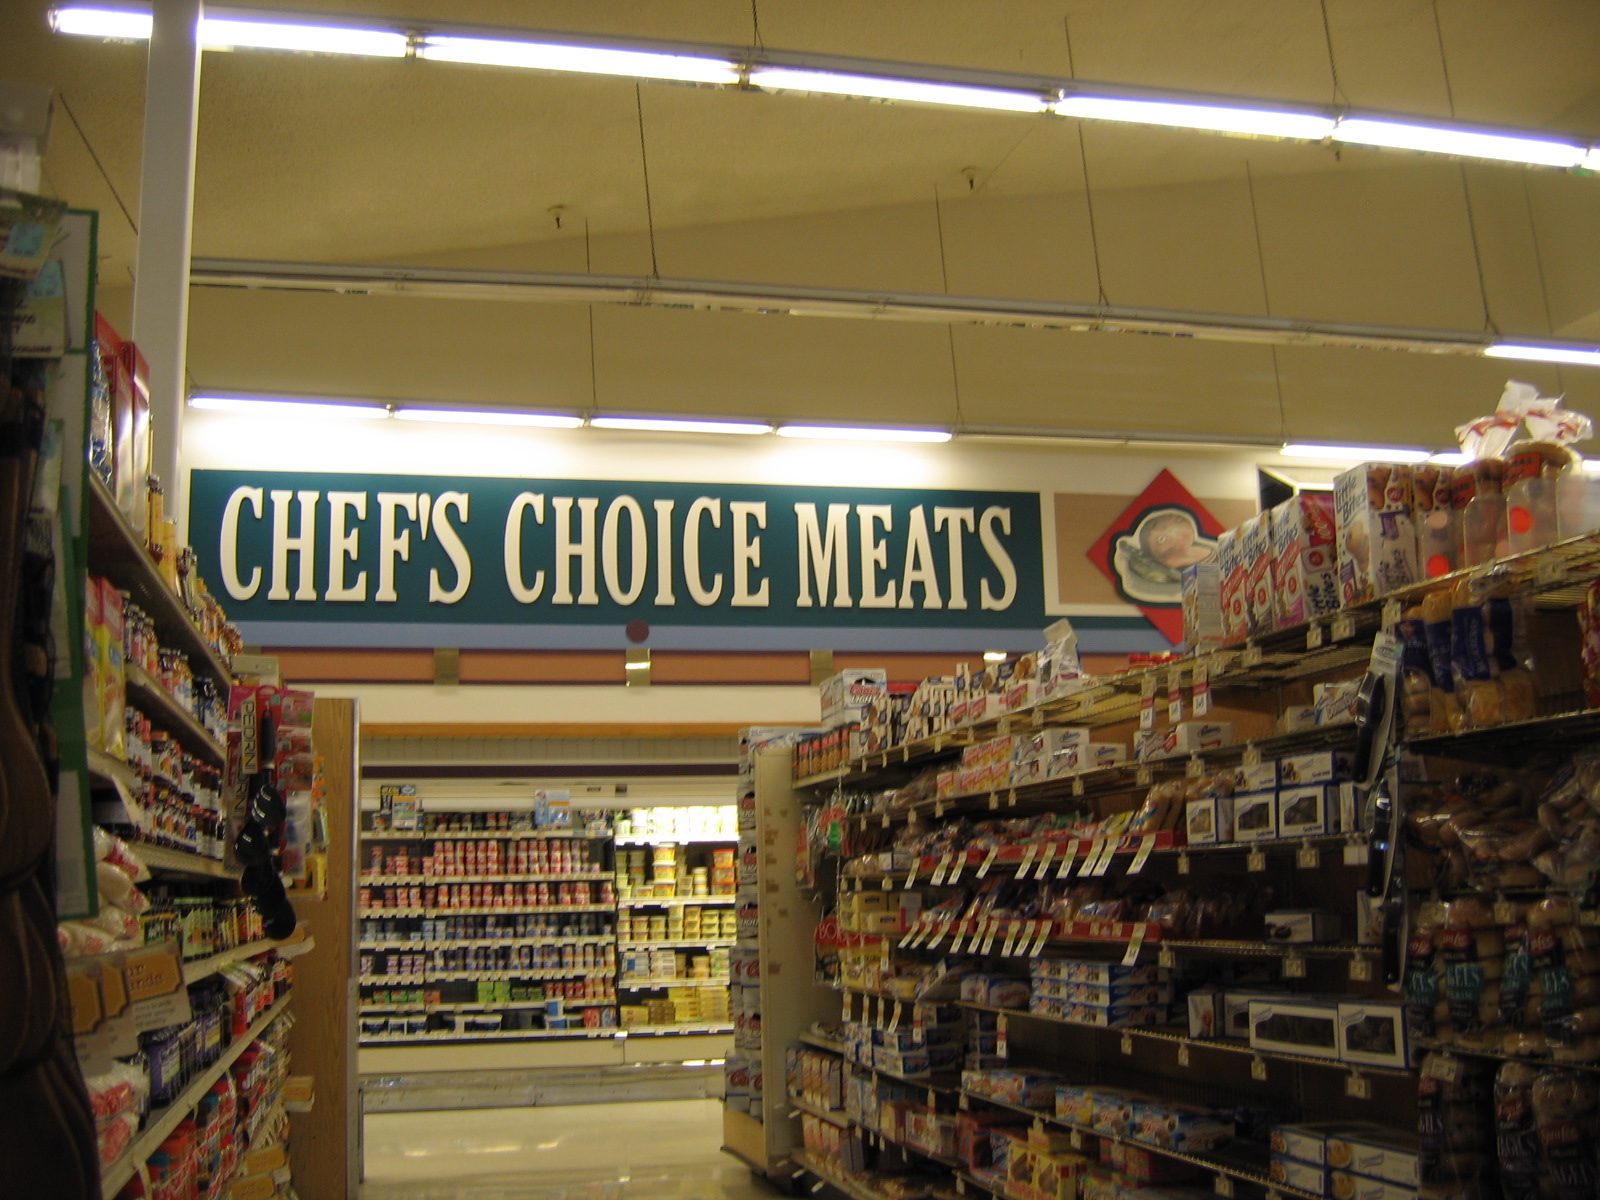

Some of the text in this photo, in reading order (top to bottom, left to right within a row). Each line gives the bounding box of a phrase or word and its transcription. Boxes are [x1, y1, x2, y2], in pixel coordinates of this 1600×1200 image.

[219, 485, 1018, 612] CHEF'S CHOICE MEATS
[242, 700, 256, 770] PEDRINI
